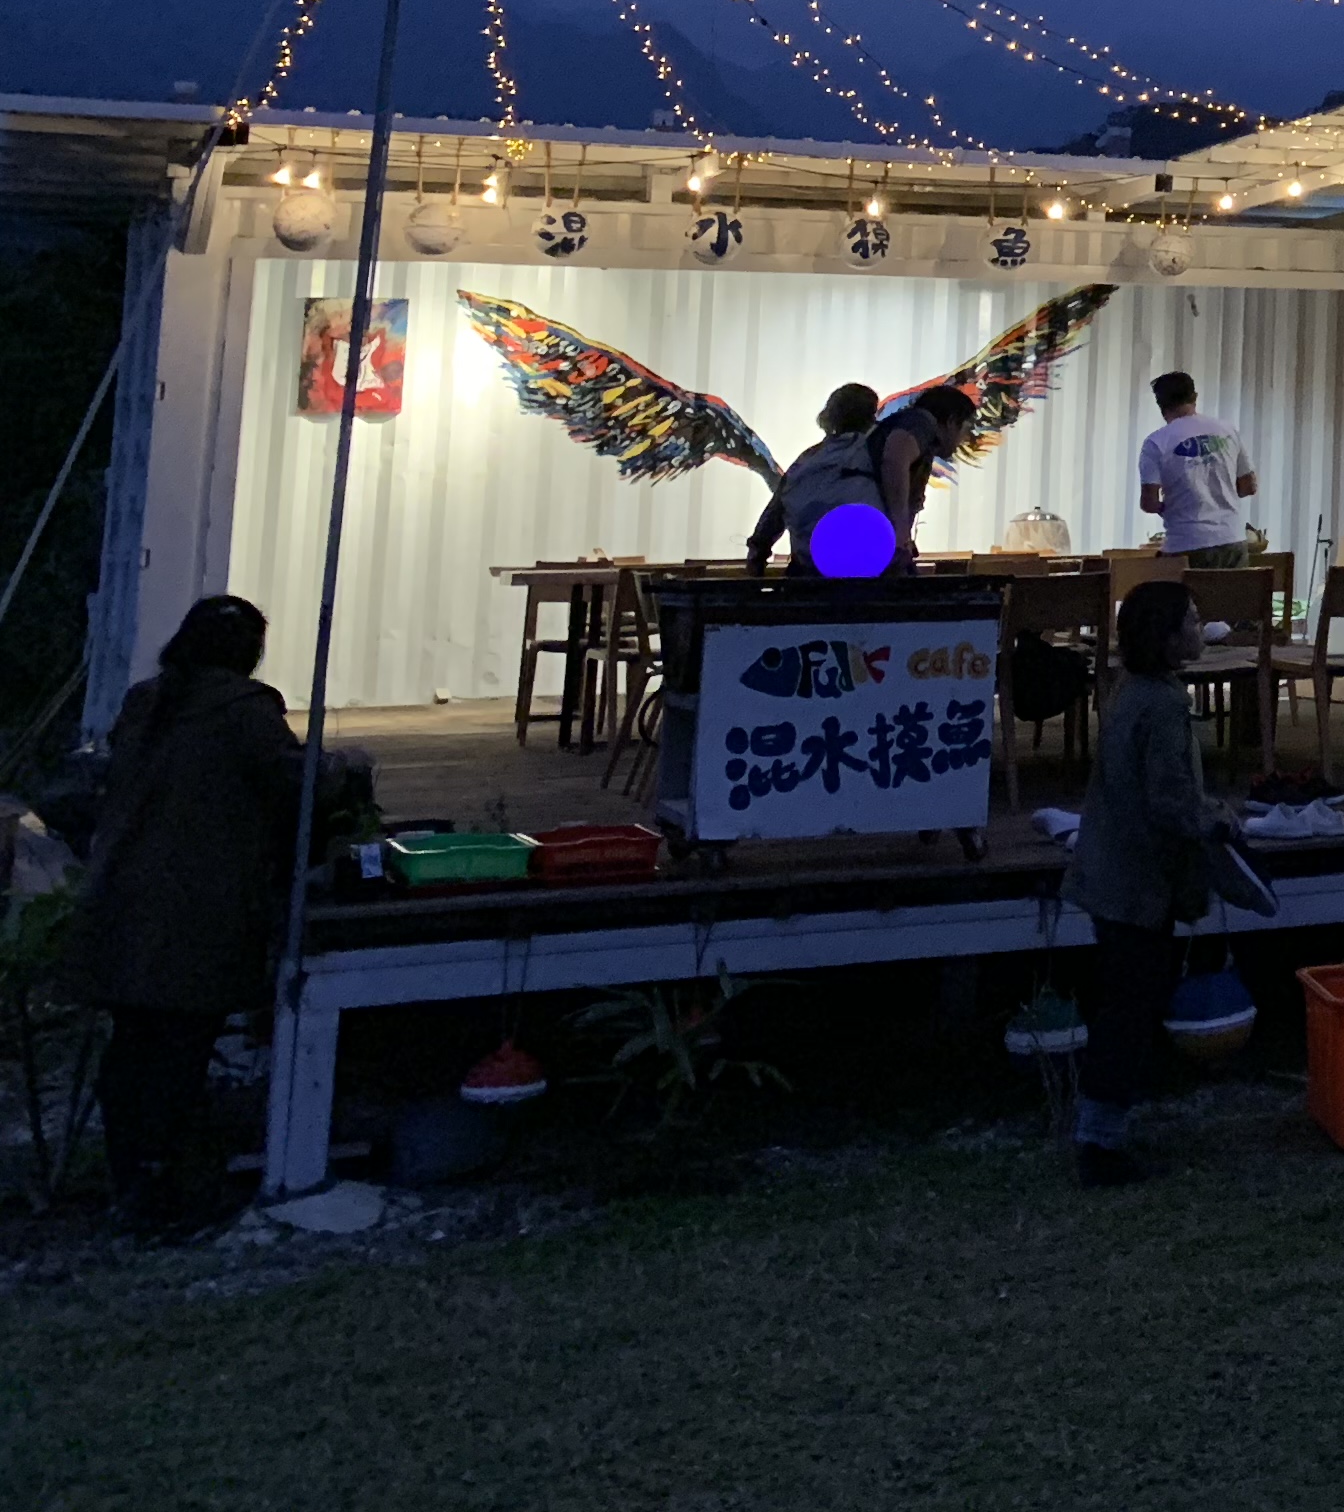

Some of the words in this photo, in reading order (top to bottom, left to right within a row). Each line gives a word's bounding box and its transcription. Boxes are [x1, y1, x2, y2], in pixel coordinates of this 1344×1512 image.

[691, 211, 743, 257] 水
[990, 227, 1030, 266] 魚
[907, 641, 991, 679] cafe
[725, 699, 991, 810] 混水摸魚
